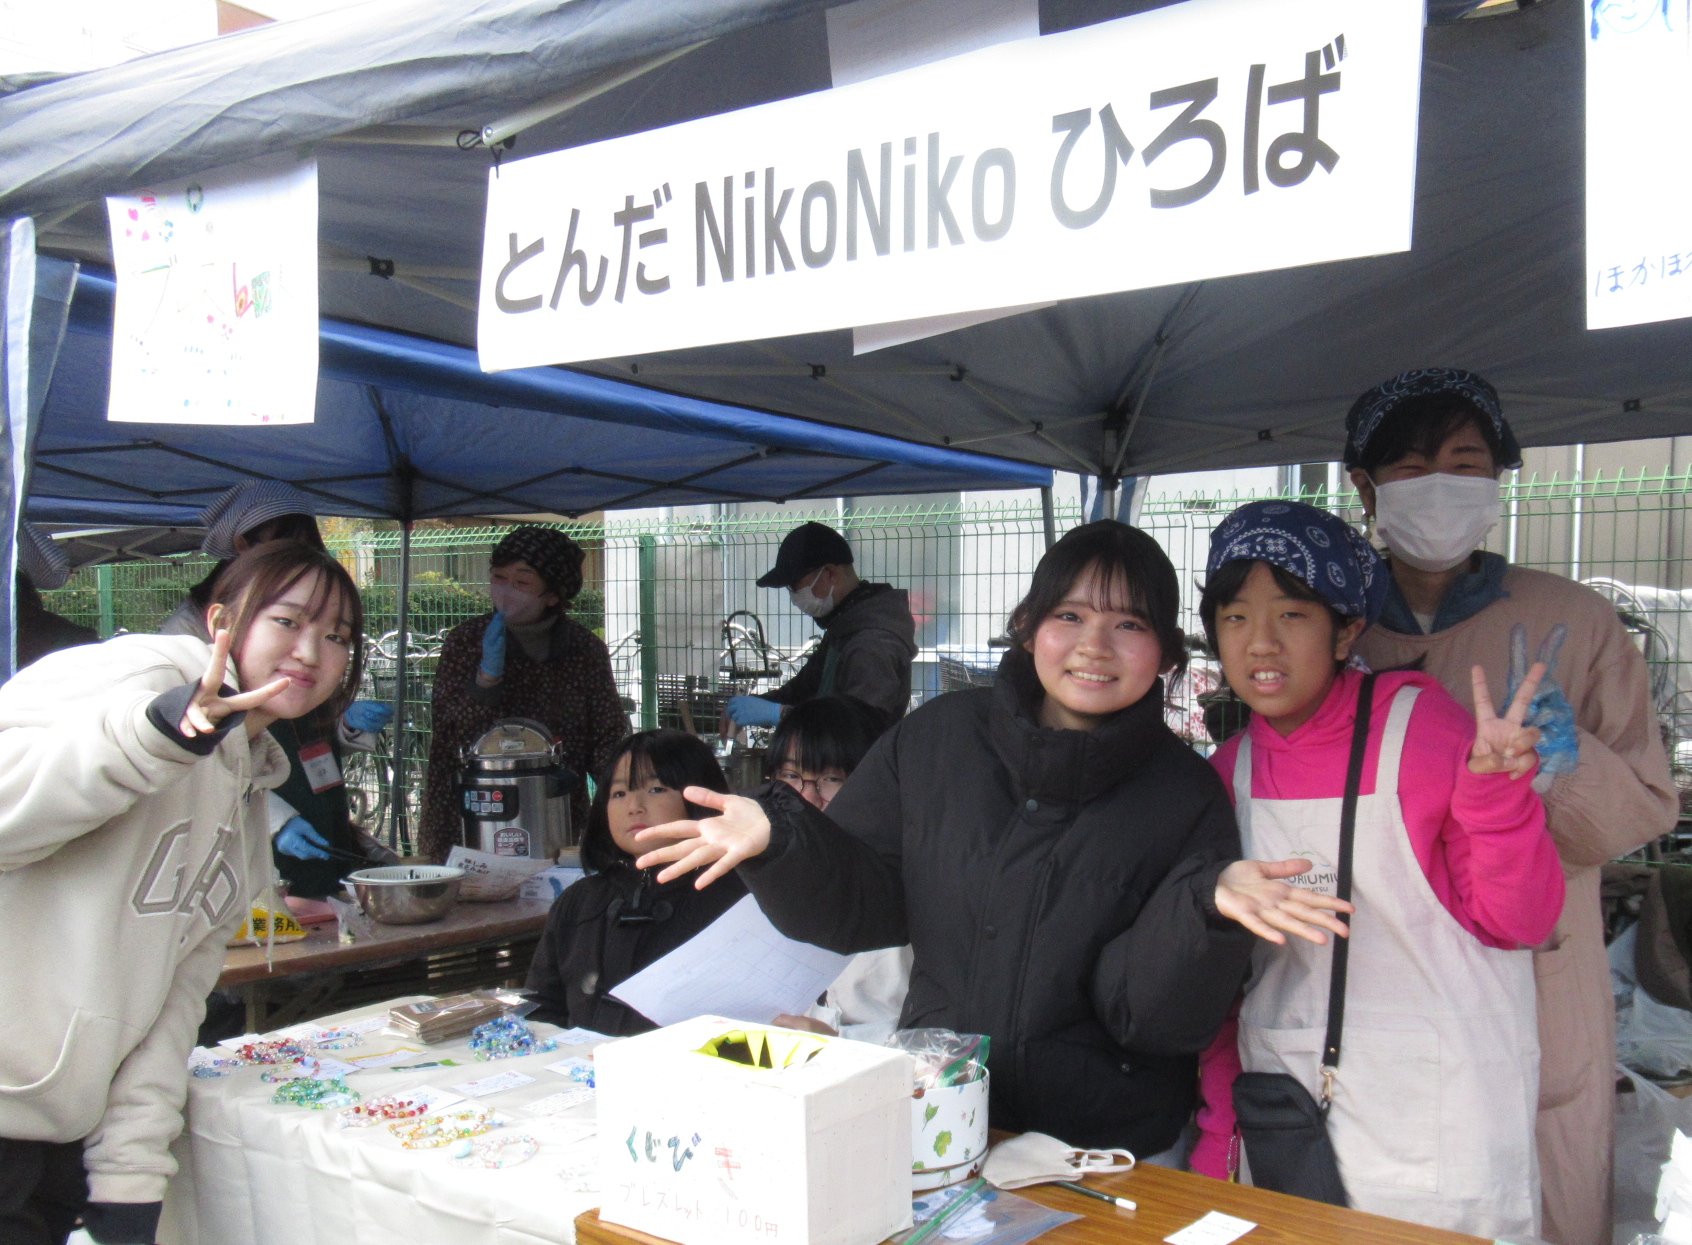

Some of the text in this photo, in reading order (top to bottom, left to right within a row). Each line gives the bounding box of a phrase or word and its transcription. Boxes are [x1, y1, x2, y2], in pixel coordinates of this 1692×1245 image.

[494, 32, 1349, 315] とんだ NikoNiko ひろば
